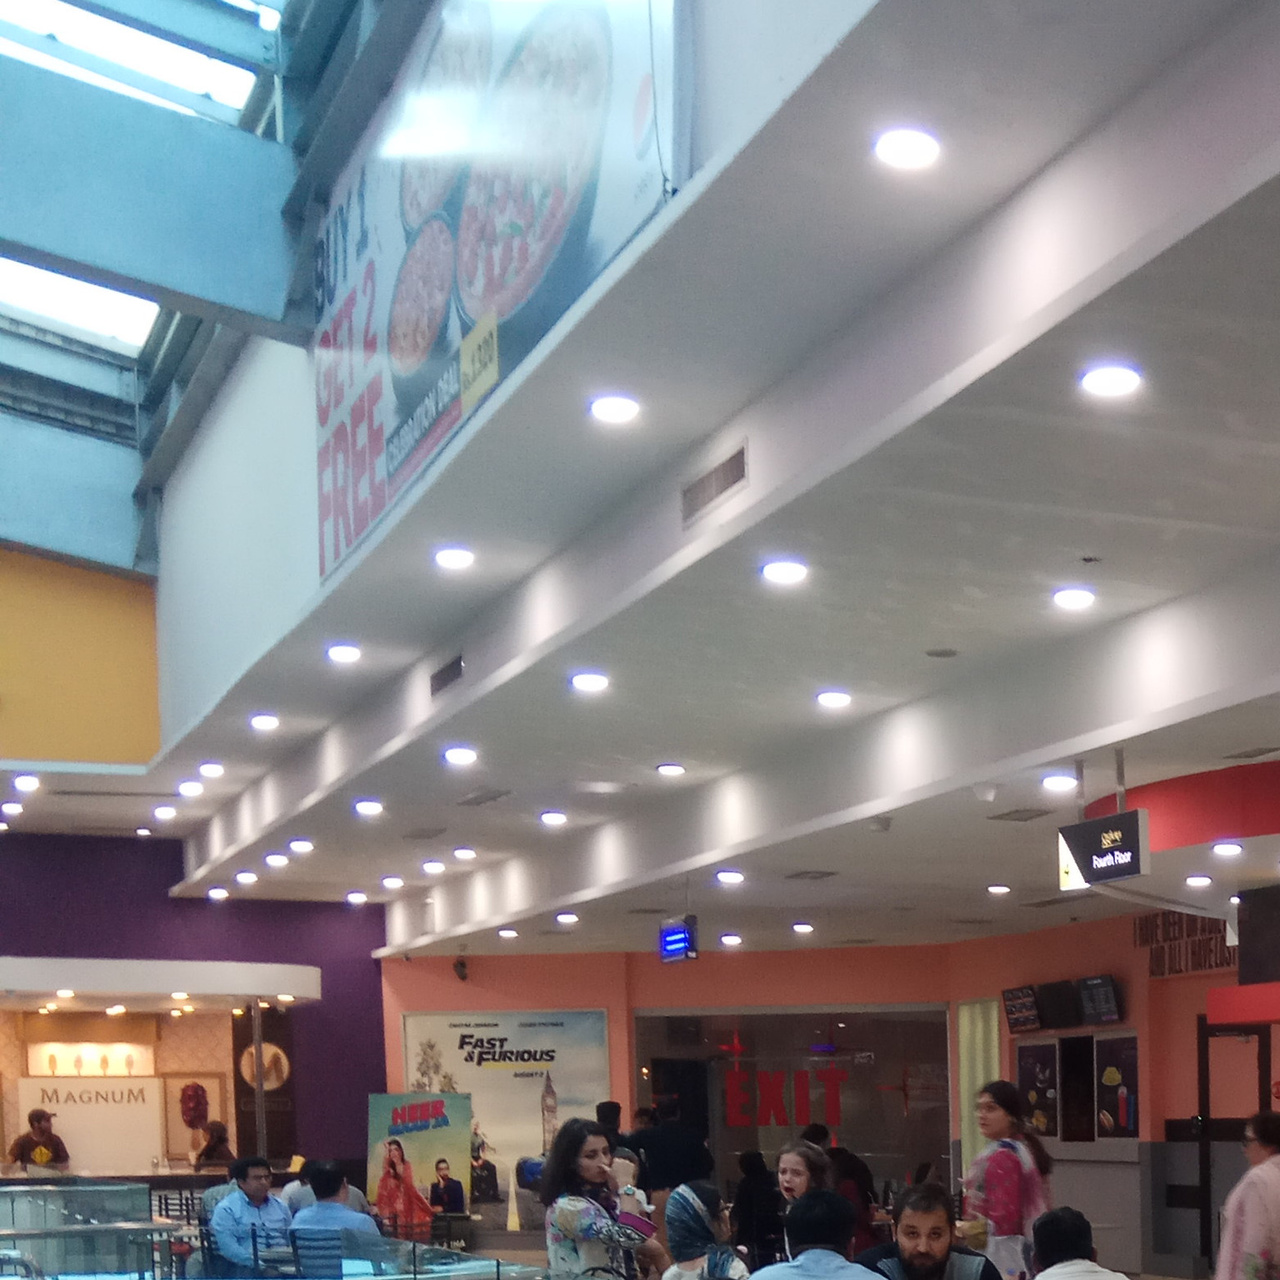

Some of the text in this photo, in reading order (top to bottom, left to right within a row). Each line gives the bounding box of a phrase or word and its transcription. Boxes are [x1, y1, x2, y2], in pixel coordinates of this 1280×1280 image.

[316, 258, 378, 429] GET 2
[317, 373, 386, 578] FREE
[1092, 850, 1132, 869] Fourth Floor
[458, 1033, 508, 1050] FAST
[476, 1049, 556, 1067] FURIOUS
[40, 1086, 146, 1105] MAGNUM
[725, 1068, 849, 1127] EXIT
